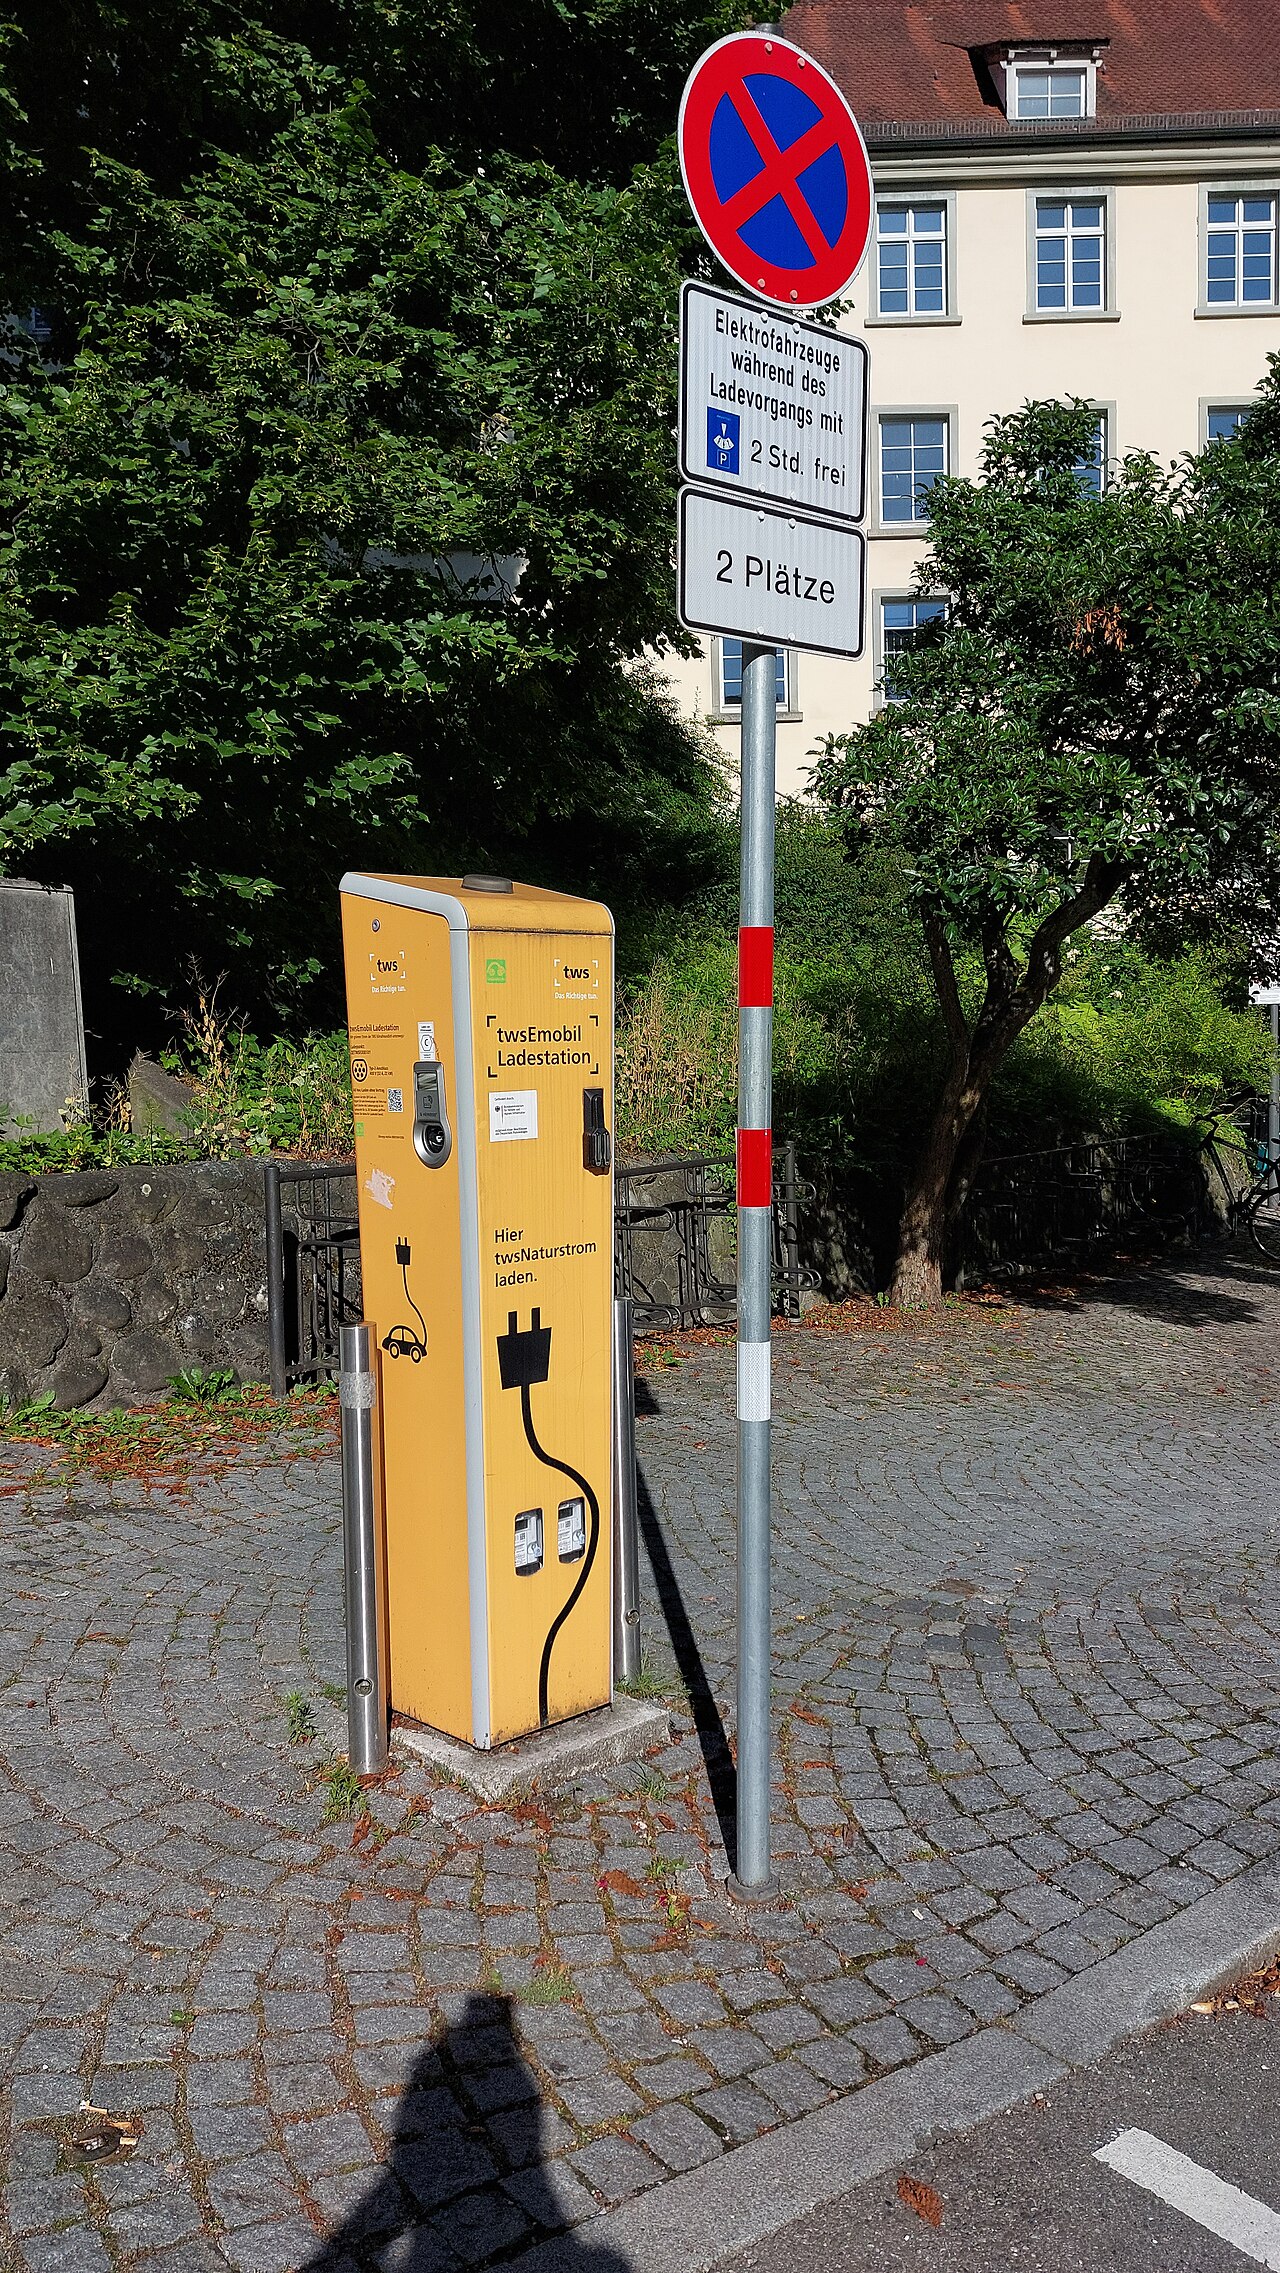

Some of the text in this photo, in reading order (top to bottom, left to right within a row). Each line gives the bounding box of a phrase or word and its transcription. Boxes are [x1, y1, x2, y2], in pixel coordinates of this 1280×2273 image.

[715, 308, 841, 374] Elektrofahrzeuge
[730, 349, 826, 397] während des
[710, 372, 843, 435] Ladevorgangs mit
[720, 452, 728, 465] P
[750, 439, 846, 487] 2 Std. frei
[716, 549, 836, 605] 2 Plätze
[376, 959, 398, 973] tws
[562, 965, 590, 980] tws
[565, 992, 587, 1001] Richtige
[496, 1025, 581, 1043] twsEmobil
[497, 1048, 591, 1066] Ladestation
[494, 1227, 524, 1244] Hier
[494, 1242, 597, 1266] twsNaturstrom
[495, 1270, 538, 1288] laden.
